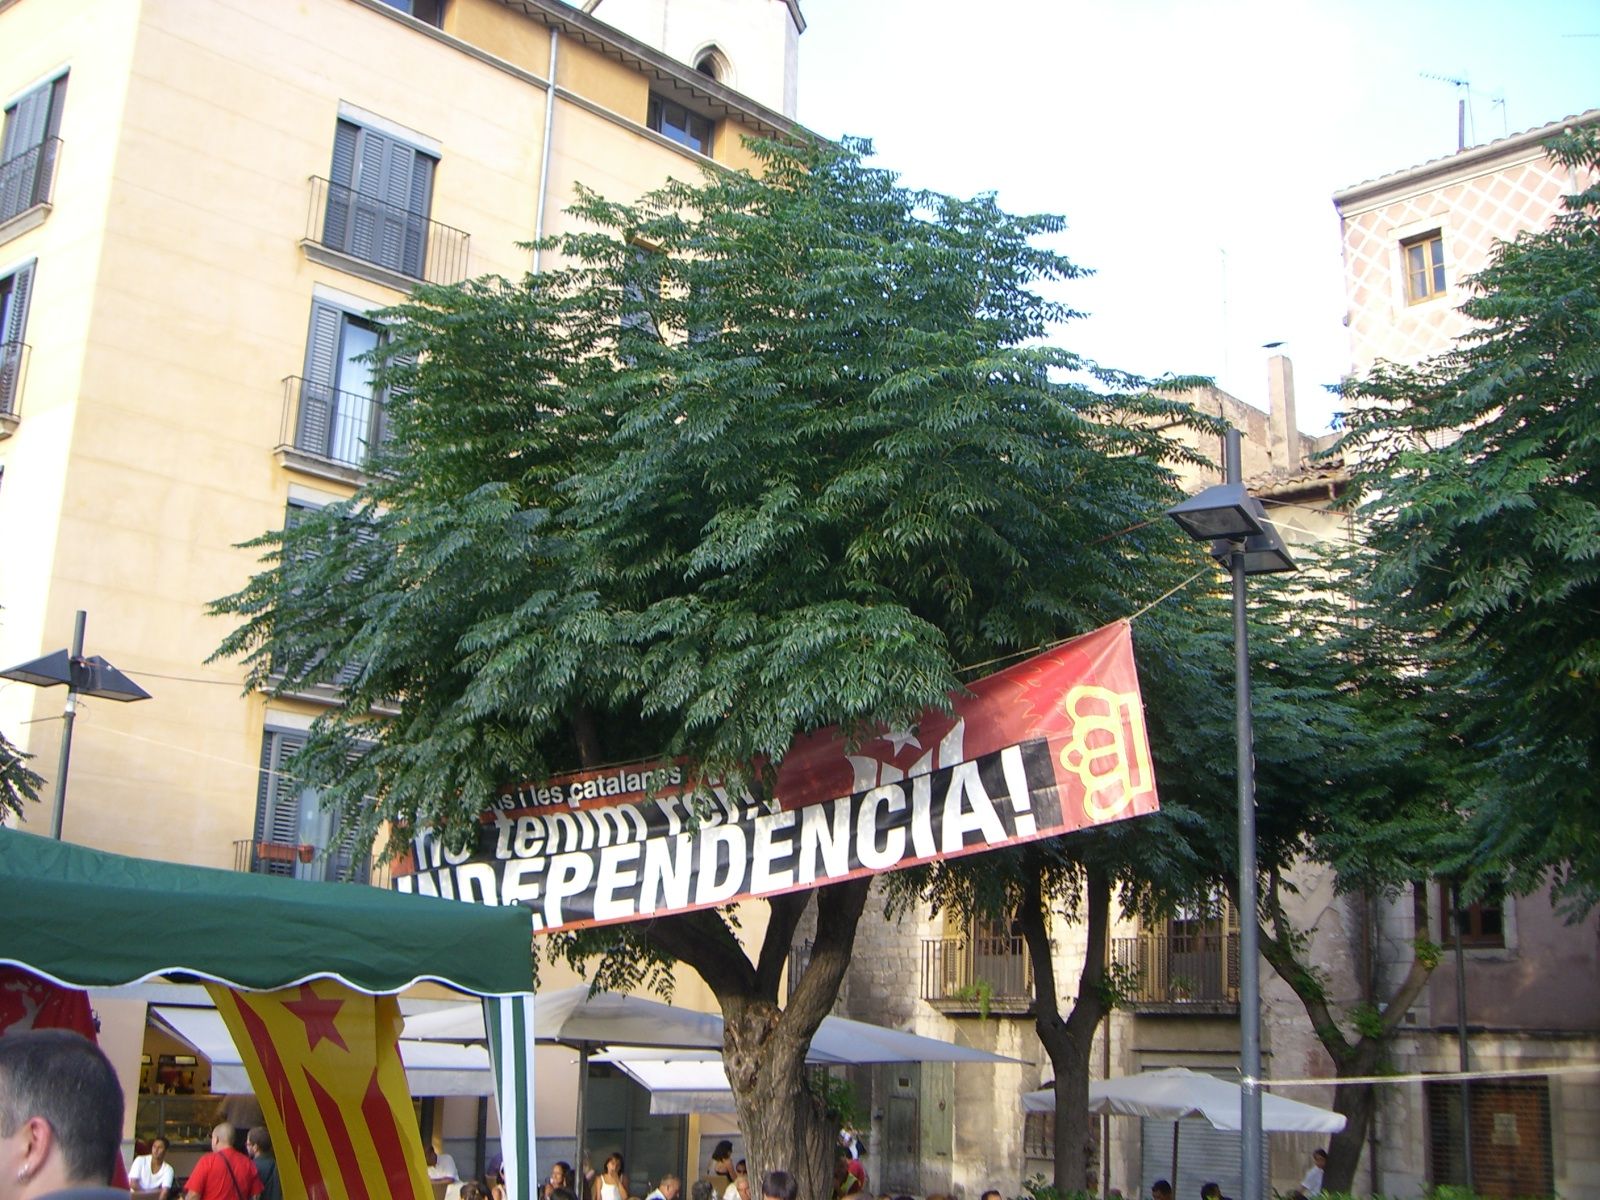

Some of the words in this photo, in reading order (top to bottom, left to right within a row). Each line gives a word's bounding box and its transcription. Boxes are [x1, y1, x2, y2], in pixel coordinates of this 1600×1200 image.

[516, 786, 527, 808] i
[530, 784, 564, 806] les
[397, 744, 1037, 931] DEPENDÈNCIA!
[495, 797, 648, 860] tenim
